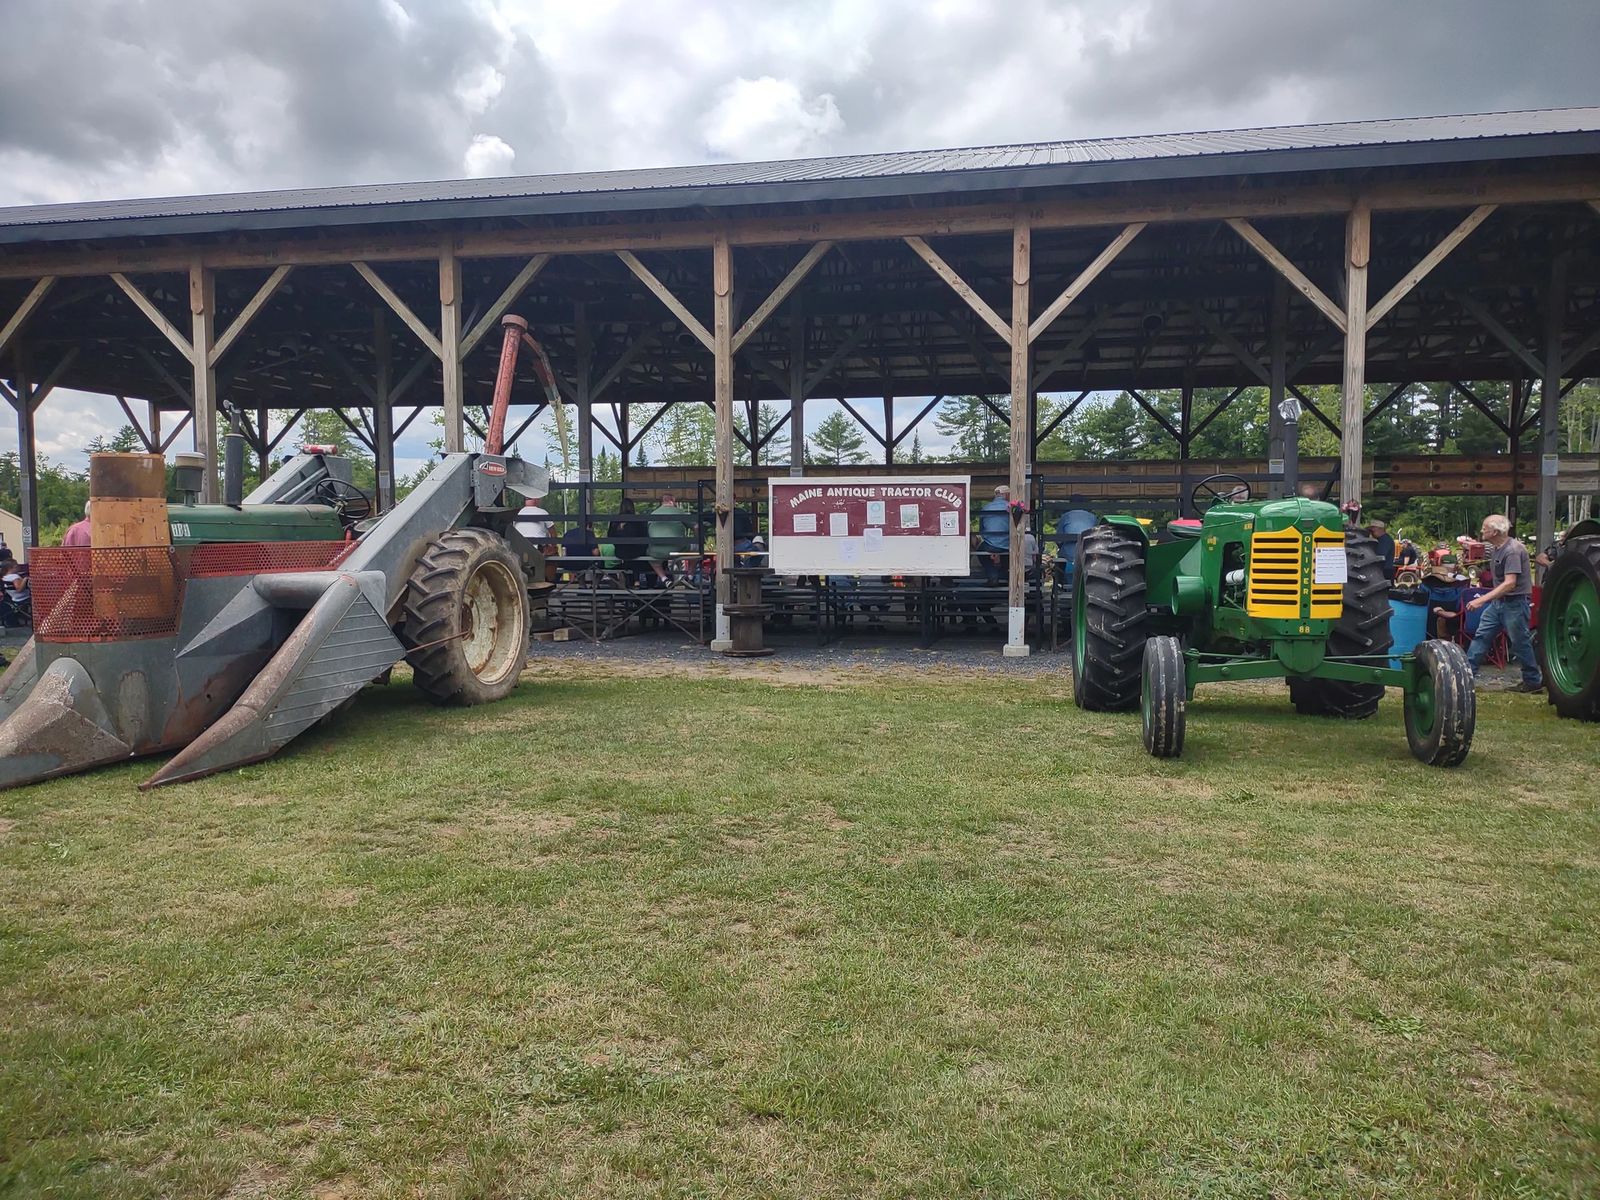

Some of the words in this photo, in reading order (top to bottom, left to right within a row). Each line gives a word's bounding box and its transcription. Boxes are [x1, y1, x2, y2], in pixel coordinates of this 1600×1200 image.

[789, 487, 823, 508] MAINE
[826, 487, 876, 497] ANTIQUE
[880, 487, 931, 497] TRACTOR
[934, 487, 962, 508] CLUB
[1303, 535, 1311, 595] OLIVER
